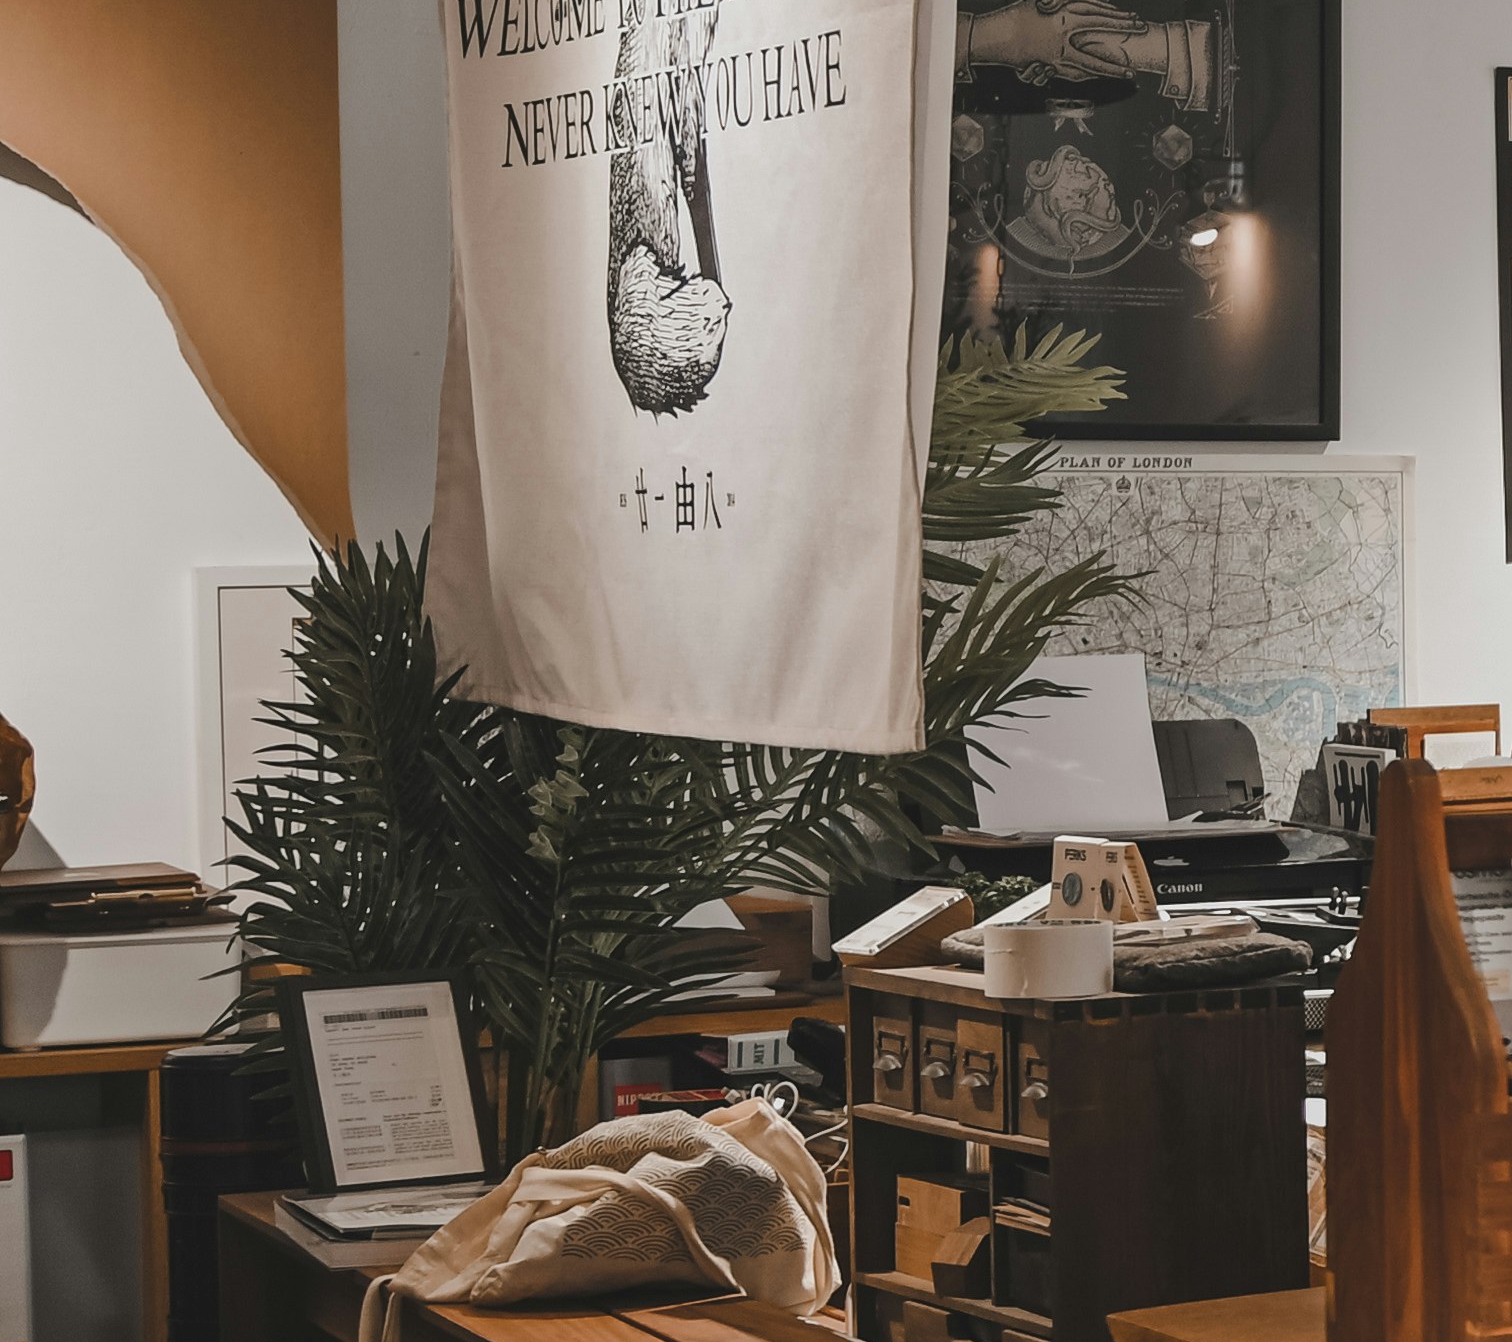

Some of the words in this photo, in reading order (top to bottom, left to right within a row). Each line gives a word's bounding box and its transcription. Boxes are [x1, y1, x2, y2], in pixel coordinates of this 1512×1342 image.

[502, 89, 597, 168] NEVER
[603, 67, 690, 151] KNEW
[693, 52, 754, 136] YOU
[761, 30, 846, 123] HAVE
[1060, 457, 1100, 468] PLAN
[1107, 457, 1126, 468] OF
[1132, 457, 1193, 468] LONDON
[1157, 883, 1203, 895] Canon
